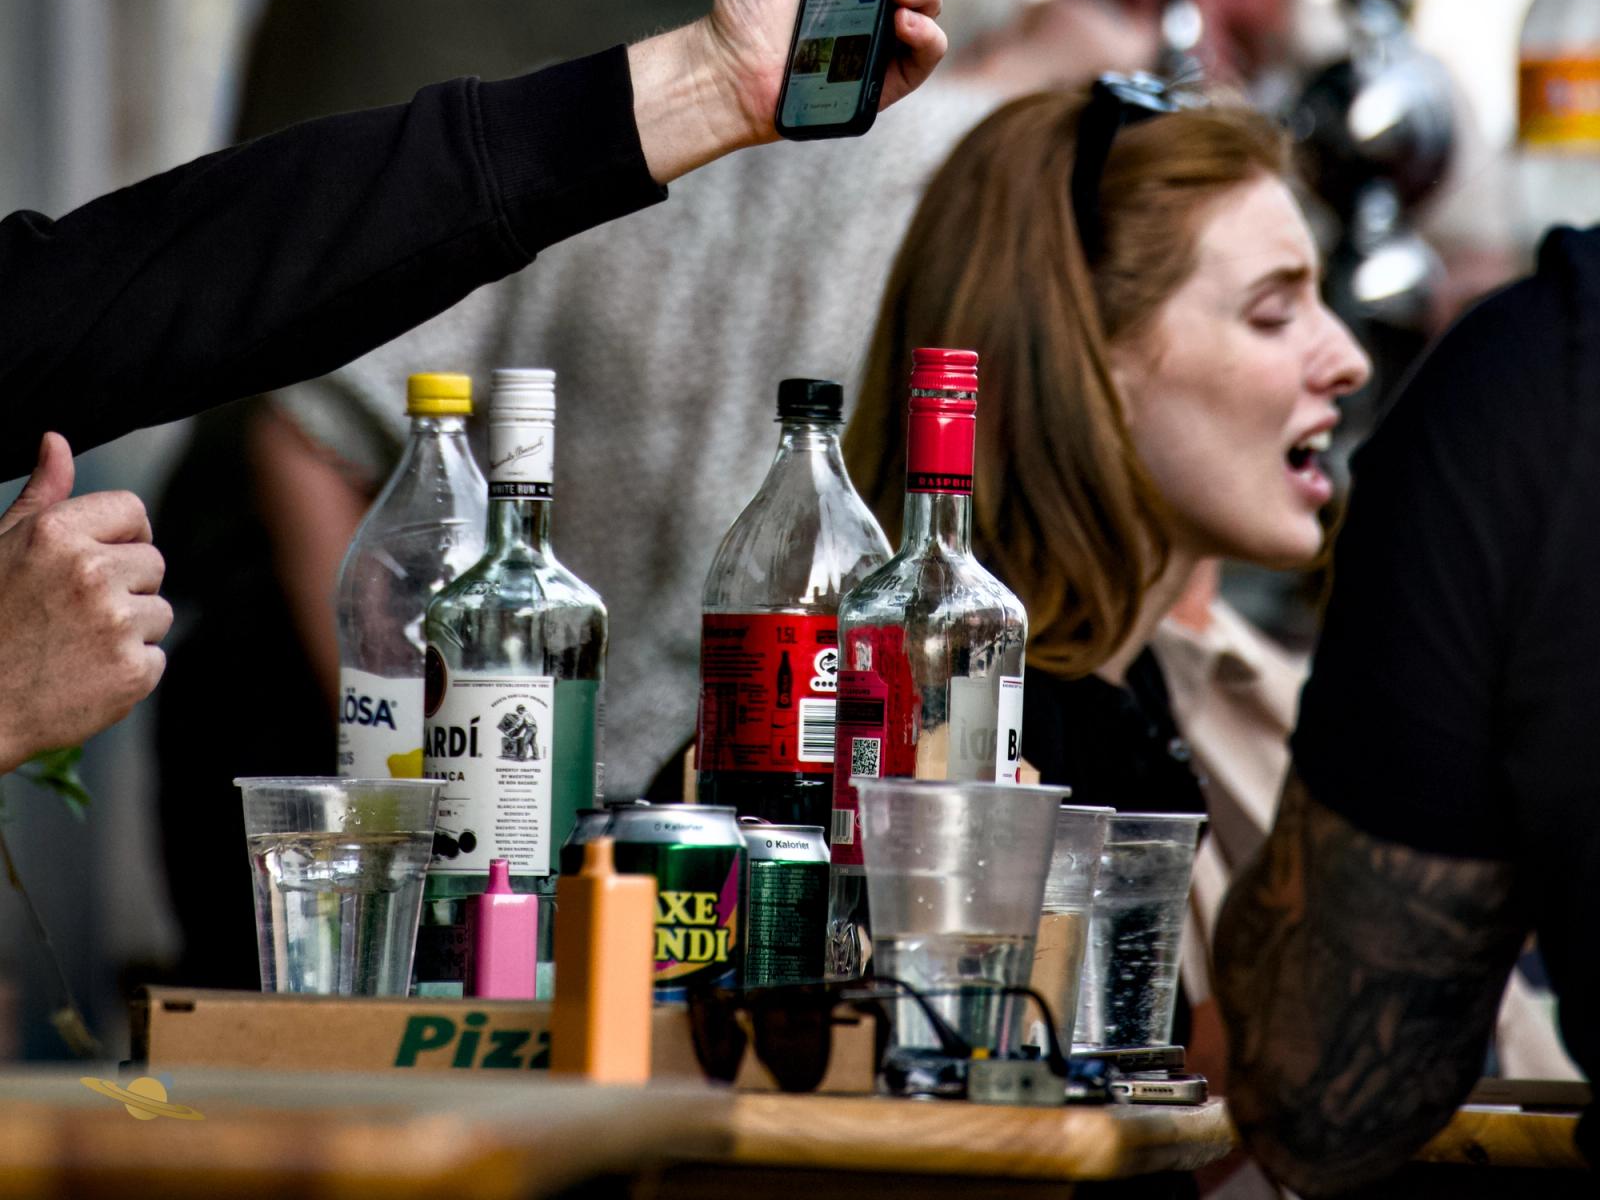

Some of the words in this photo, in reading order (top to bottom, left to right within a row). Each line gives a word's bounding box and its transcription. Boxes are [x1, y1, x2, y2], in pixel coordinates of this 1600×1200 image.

[517, 484, 537, 495] RUM
[765, 839, 773, 848] 0
[775, 839, 810, 850] Kalorier
